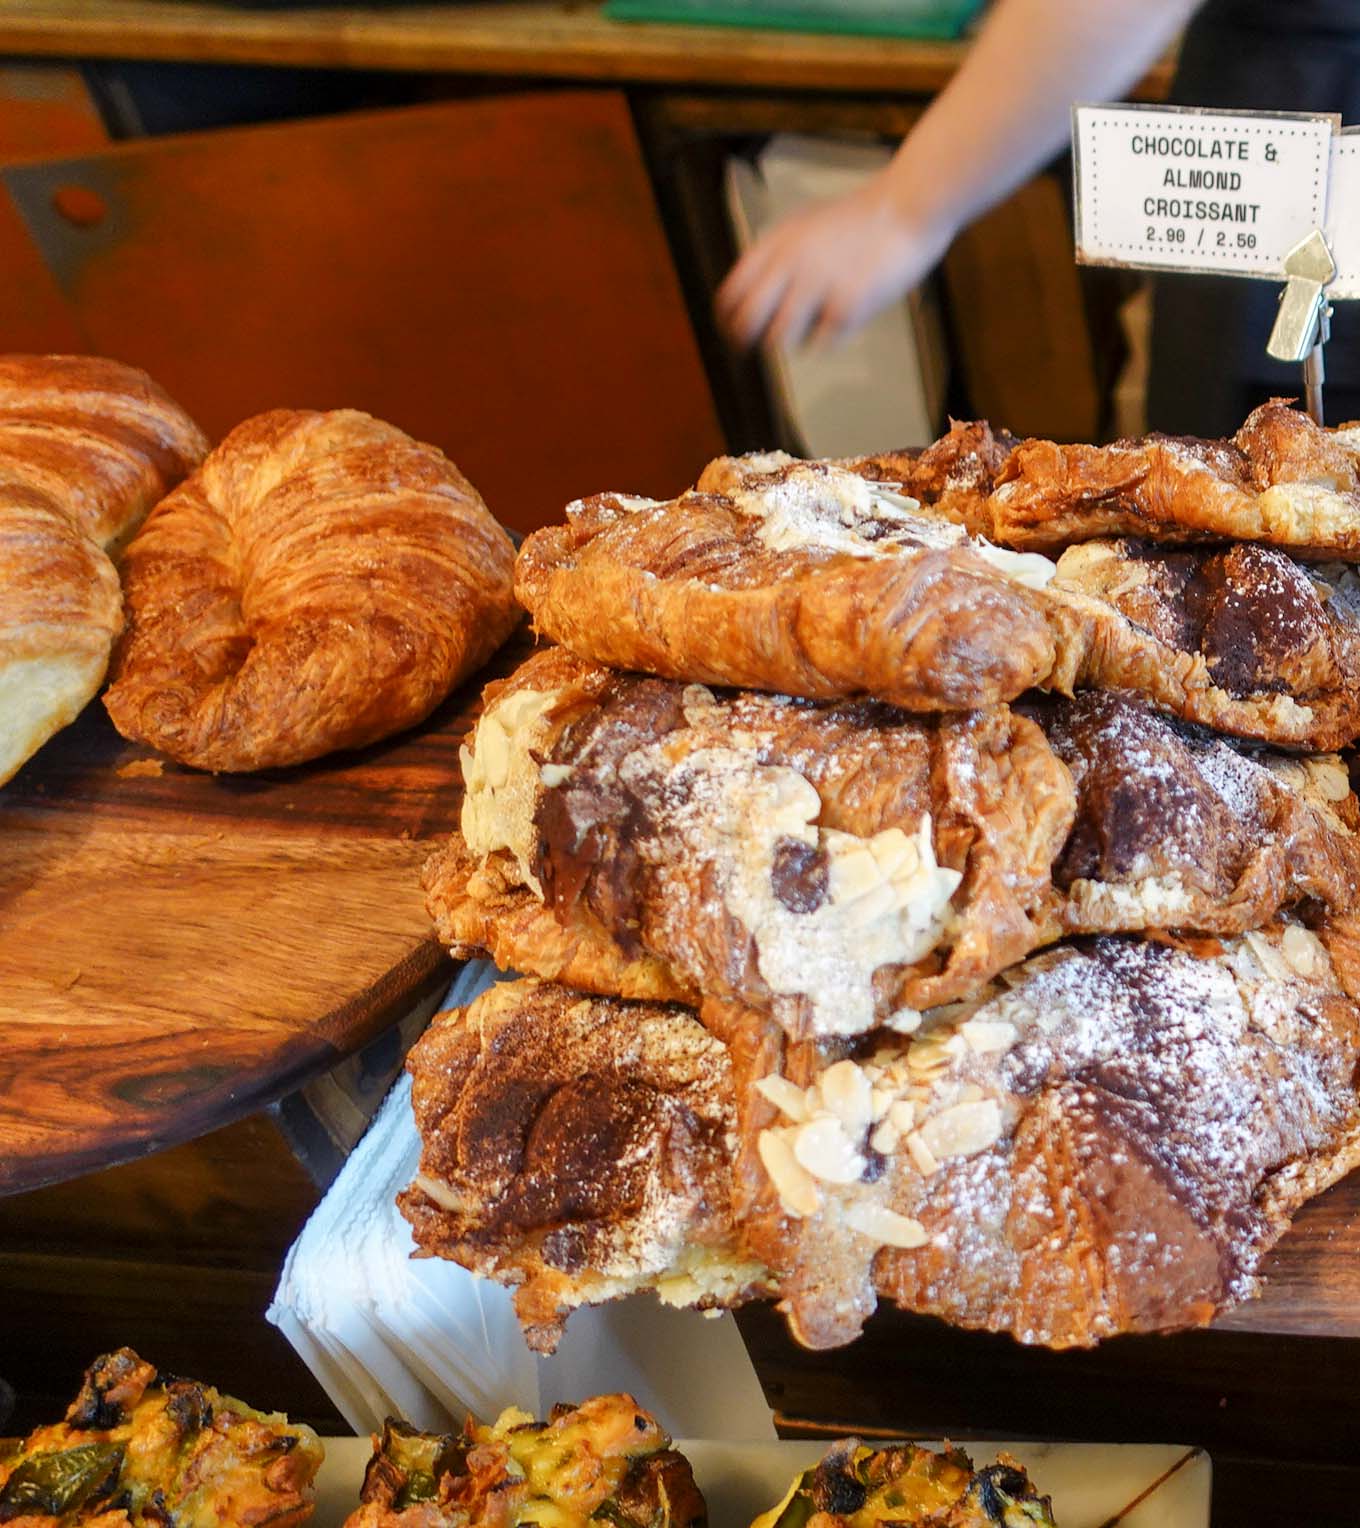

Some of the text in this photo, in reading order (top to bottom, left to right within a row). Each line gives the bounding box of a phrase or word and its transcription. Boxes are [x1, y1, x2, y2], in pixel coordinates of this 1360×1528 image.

[1131, 135, 1278, 162] CHOCOLATE &
[1163, 168, 1241, 191] ALMOND
[1144, 198, 1260, 223] CROISSANT
[1146, 226, 1257, 249] 2.90 / 2.50
